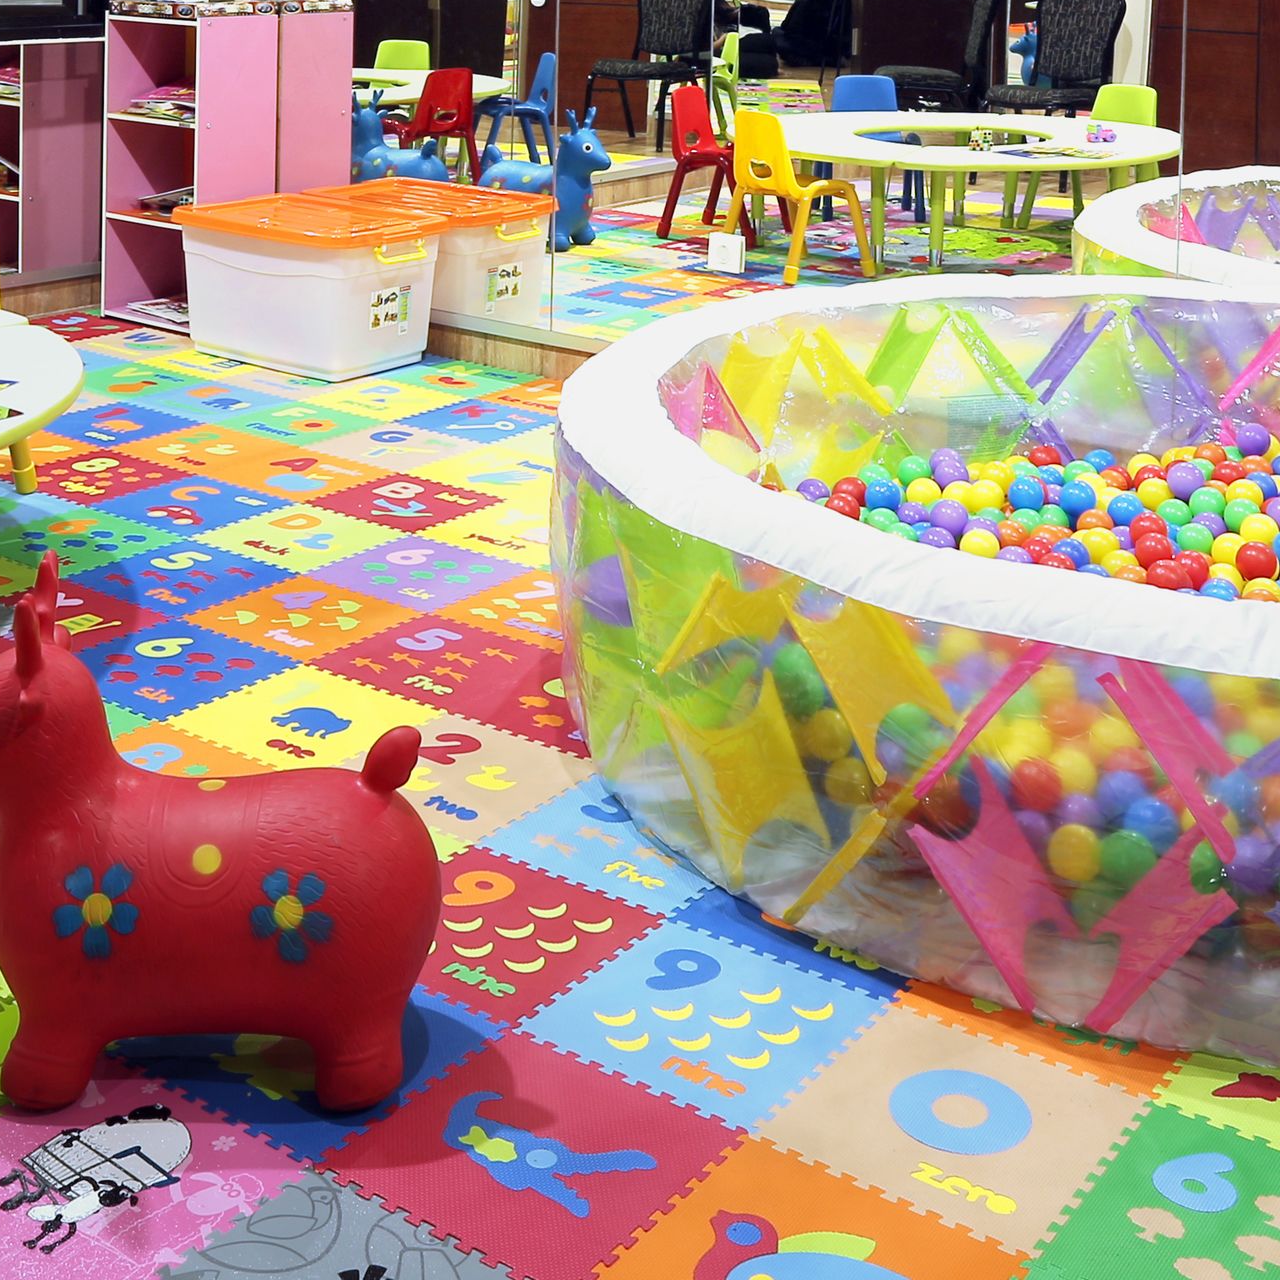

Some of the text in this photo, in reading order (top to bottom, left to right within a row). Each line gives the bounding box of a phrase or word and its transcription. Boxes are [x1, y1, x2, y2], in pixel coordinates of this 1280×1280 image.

[123, 332, 167, 343] W
[112, 368, 154, 378] V
[360, 385, 401, 395] P
[274, 406, 318, 421] F
[450, 406, 498, 418] K
[369, 430, 415, 443] G
[71, 457, 121, 473] 8
[269, 458, 318, 471] A
[58, 480, 106, 496] eight
[170, 485, 221, 501] C
[371, 481, 427, 499] B
[48, 519, 99, 535] 6
[268, 513, 322, 531] D
[243, 539, 291, 556] duck
[385, 548, 435, 566] 6
[150, 551, 213, 571] 5
[144, 587, 187, 606] five
[272, 590, 329, 611] 4
[398, 586, 436, 601] six
[133, 636, 195, 659] 6
[263, 628, 315, 648] four
[395, 627, 464, 652] 5
[402, 674, 455, 696] five
[133, 686, 176, 704] six
[118, 742, 185, 772] 8
[266, 738, 317, 759] one
[416, 731, 483, 766] 2
[423, 795, 479, 822] two
[602, 859, 666, 890] five
[441, 870, 516, 907] 9
[645, 948, 722, 991] 9
[440, 962, 517, 998] nine
[659, 1055, 748, 1099] nine
[887, 1068, 1033, 1157] 0
[910, 1161, 1018, 1215] zero
[1151, 1151, 1240, 1215] 6
